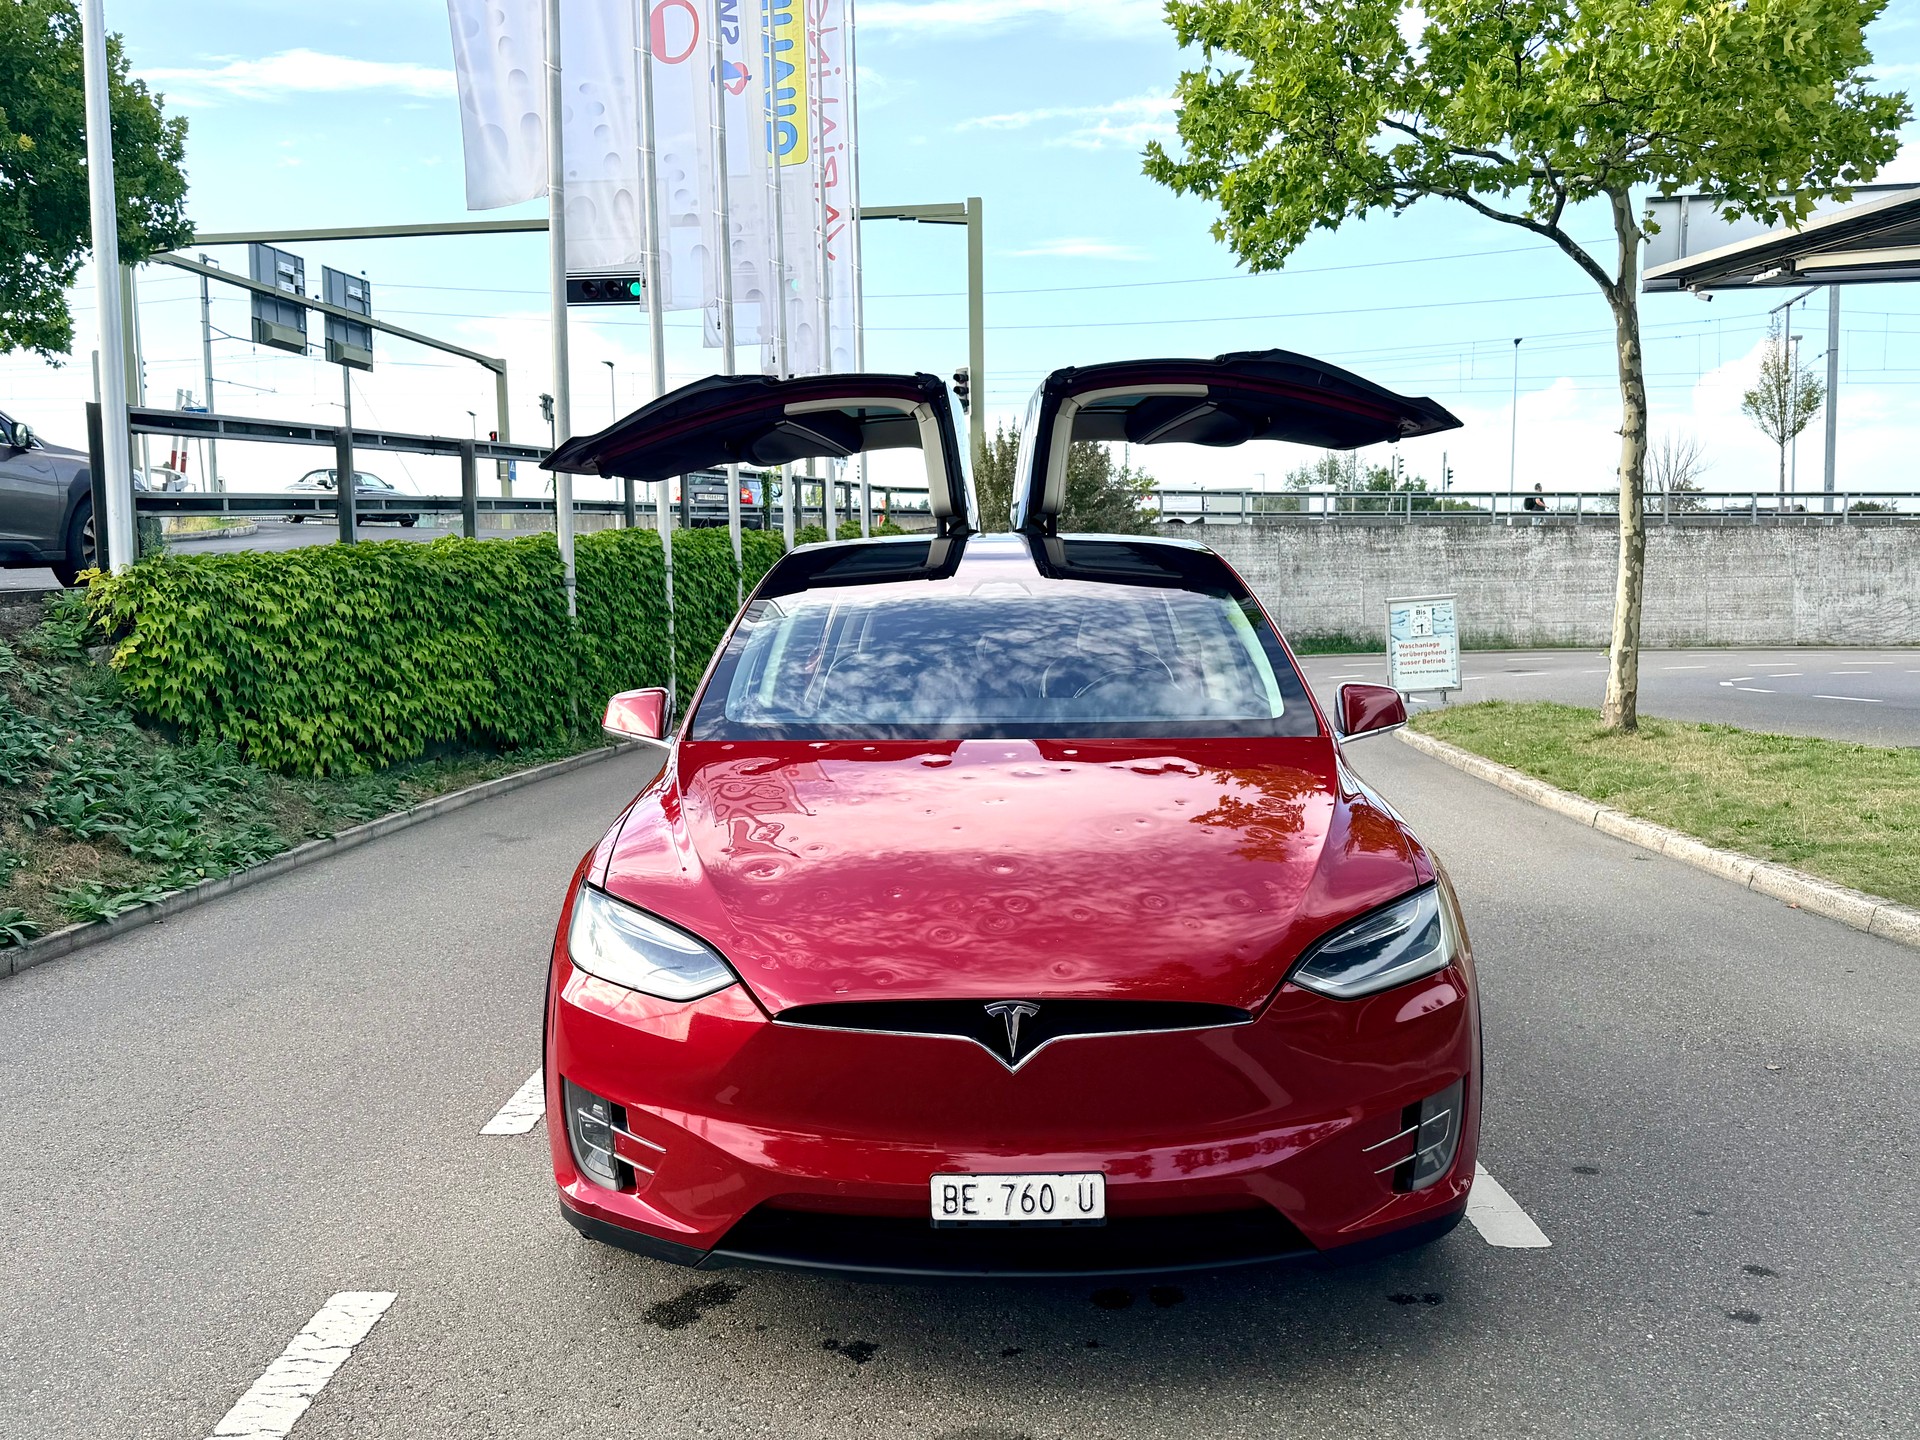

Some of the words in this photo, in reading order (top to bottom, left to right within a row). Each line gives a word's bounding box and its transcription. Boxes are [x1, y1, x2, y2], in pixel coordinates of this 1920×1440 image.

[1398, 642, 1441, 650] Waschanlage
[1399, 649, 1447, 658] vorübergehend
[943, 1183, 978, 1215] BE
[1001, 1182, 1055, 1215] 760
[1077, 1182, 1094, 1213] U
